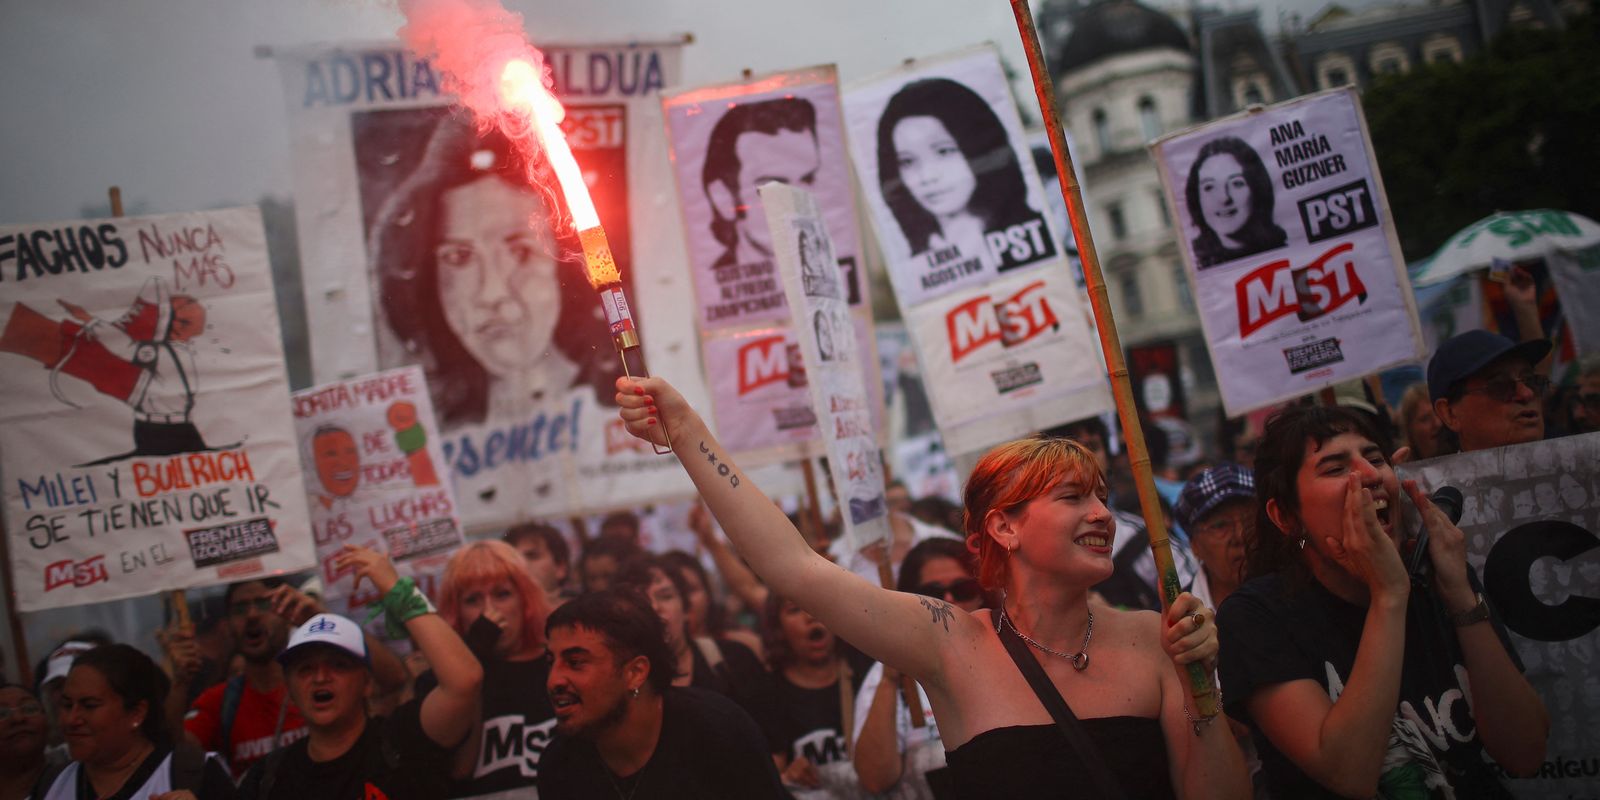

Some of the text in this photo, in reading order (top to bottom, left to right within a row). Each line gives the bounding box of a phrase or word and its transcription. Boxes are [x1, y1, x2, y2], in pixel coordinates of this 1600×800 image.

[304, 42, 665, 108] ADRIA ALDÚA
[1270, 119, 1305, 147] ANA
[1274, 134, 1332, 168] MARÍA
[1282, 154, 1347, 190] GUZNER
[1305, 187, 1365, 237] PST
[138, 223, 224, 264] NUNCA
[986, 220, 1047, 266] PST
[1244, 255, 1356, 328] MST
[950, 289, 1051, 354] MST
[18, 450, 256, 510] MILEI Y BULLRICH
[26, 484, 281, 550] SE TIENEN QUE IR
[190, 523, 251, 546] FRENTE
[313, 513, 354, 547] LAS
[368, 490, 454, 530] LUCHAS
[47, 544, 176, 587] MST EN EL
[192, 529, 277, 561] IZQUIERDA
[482, 720, 551, 770] MS
